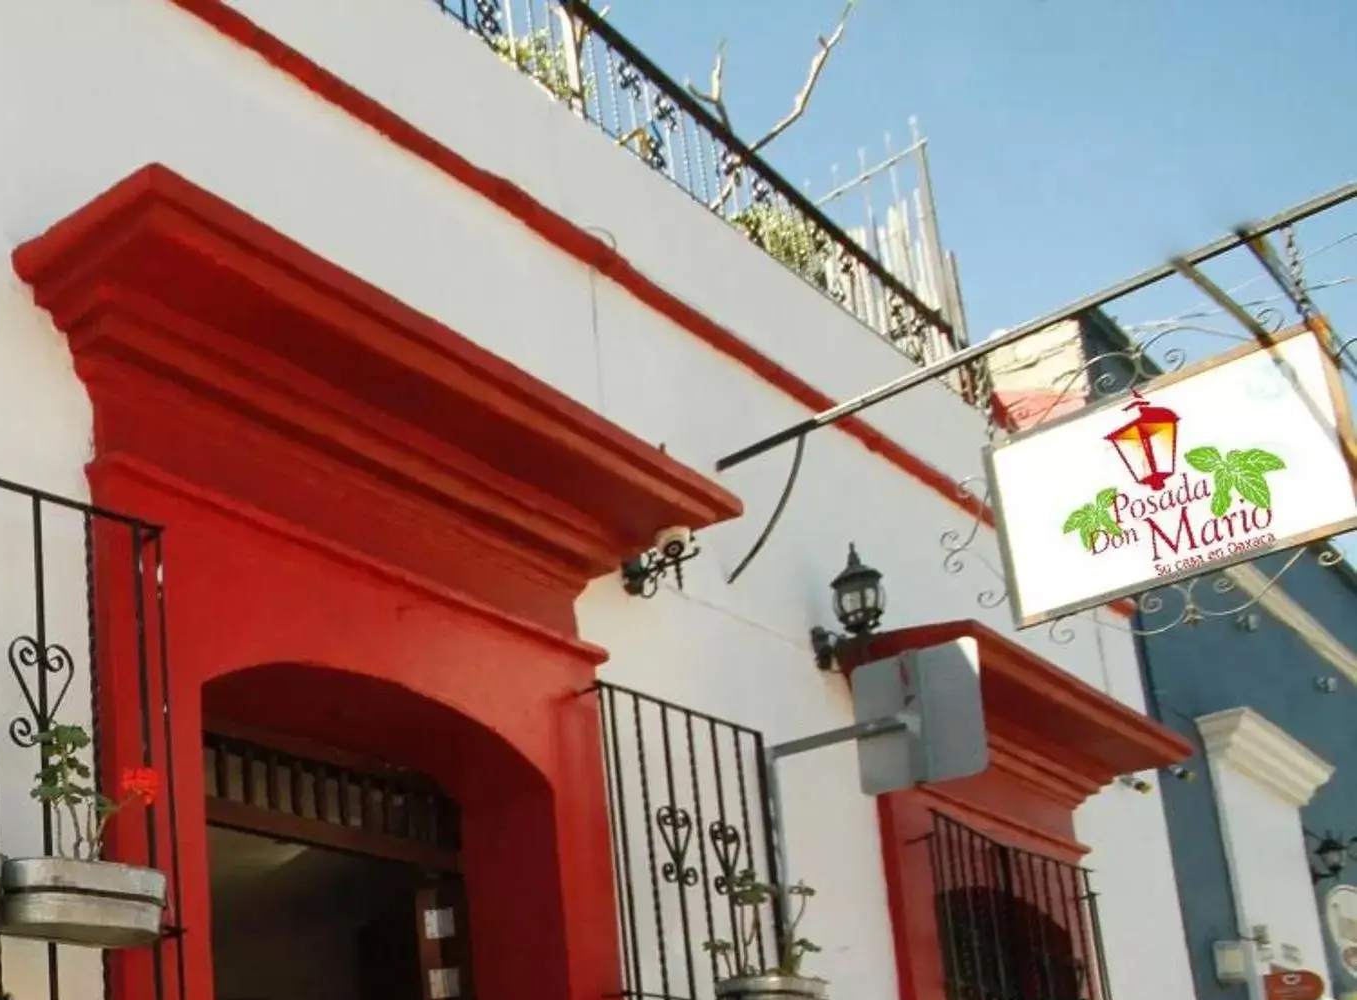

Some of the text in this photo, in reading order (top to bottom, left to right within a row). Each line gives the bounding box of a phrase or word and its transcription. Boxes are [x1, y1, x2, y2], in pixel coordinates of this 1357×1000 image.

[1110, 473, 1211, 524] Posada
[1089, 498, 1273, 561] Don Mario
[1154, 531, 1276, 577] Su casa en Oaxaca
